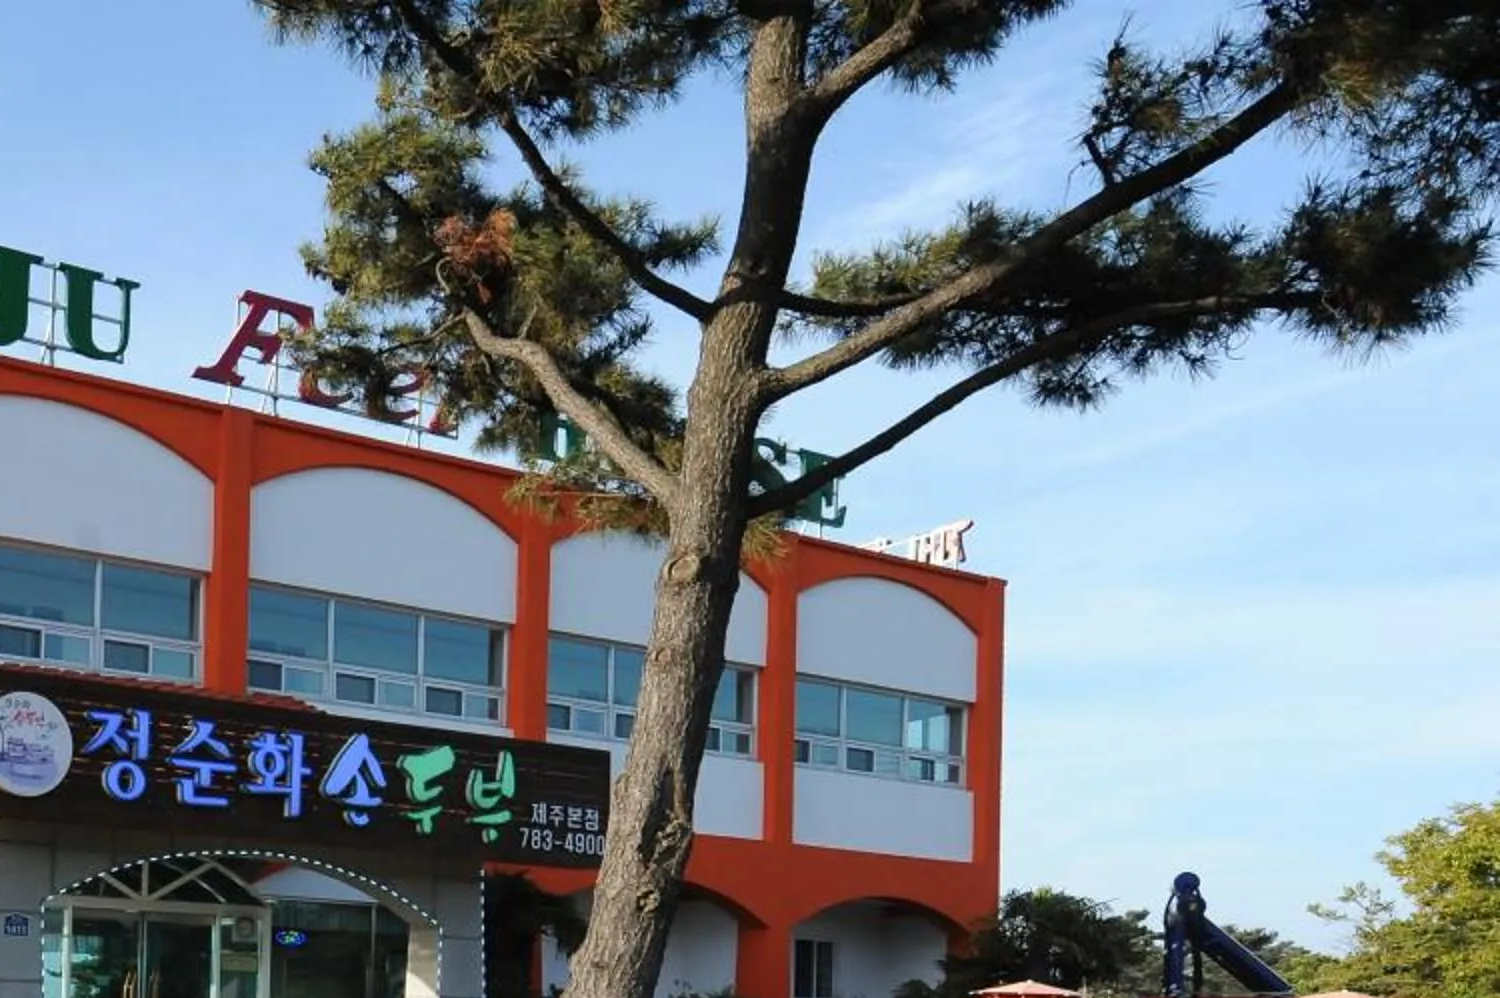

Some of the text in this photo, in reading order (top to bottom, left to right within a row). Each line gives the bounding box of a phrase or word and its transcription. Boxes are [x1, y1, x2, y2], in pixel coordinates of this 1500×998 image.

[81, 707, 313, 819] 정순화
[531, 802, 600, 831] 제주본점
[519, 827, 606, 856] 783-4900
